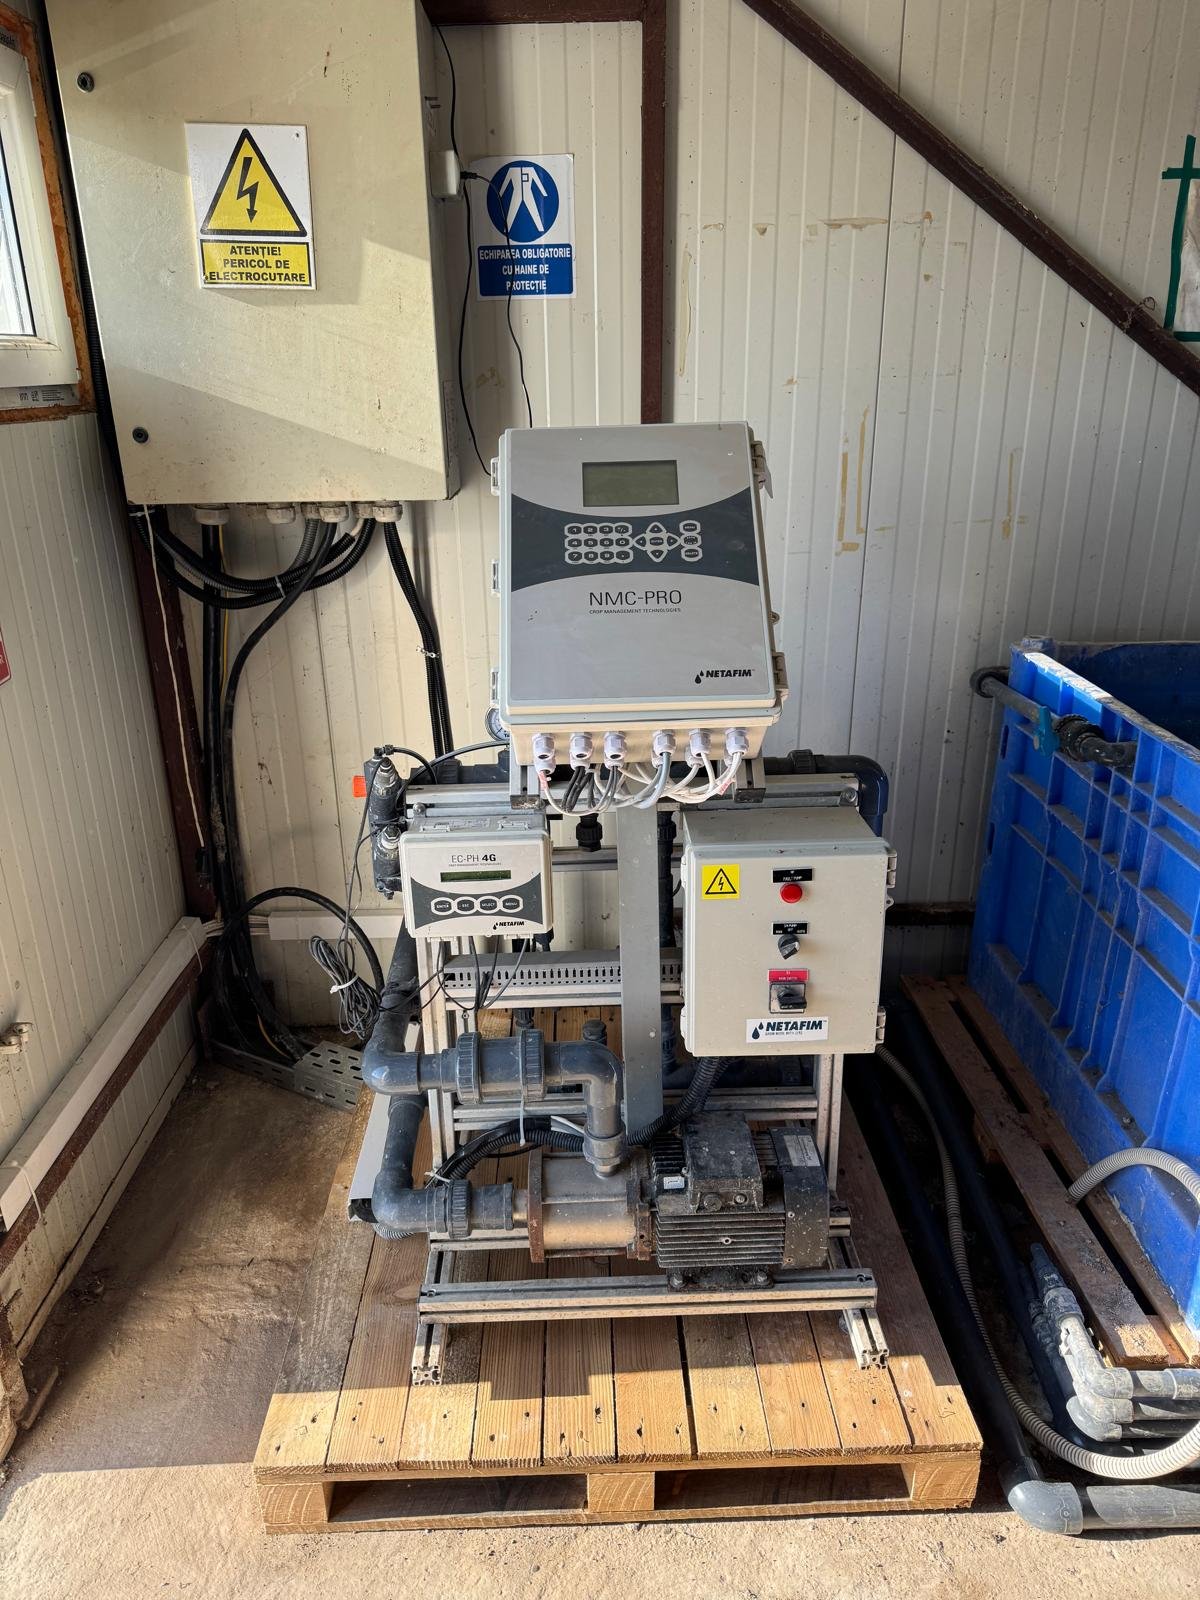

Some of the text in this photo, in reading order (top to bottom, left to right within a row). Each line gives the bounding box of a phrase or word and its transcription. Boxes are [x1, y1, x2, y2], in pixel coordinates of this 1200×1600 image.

[480, 247, 571, 260] ECHIPAREA OBLIGATORIE
[223, 258, 290, 269] PERICOL DE
[502, 264, 550, 275] CU HAINE DE
[209, 272, 306, 282] ELECTROCUTARE
[589, 590, 682, 606] NMC-PRO
[706, 669, 752, 678] NETAFIM
[451, 853, 497, 863] EC-PH 4G
[766, 1020, 823, 1032] NETAFIM
